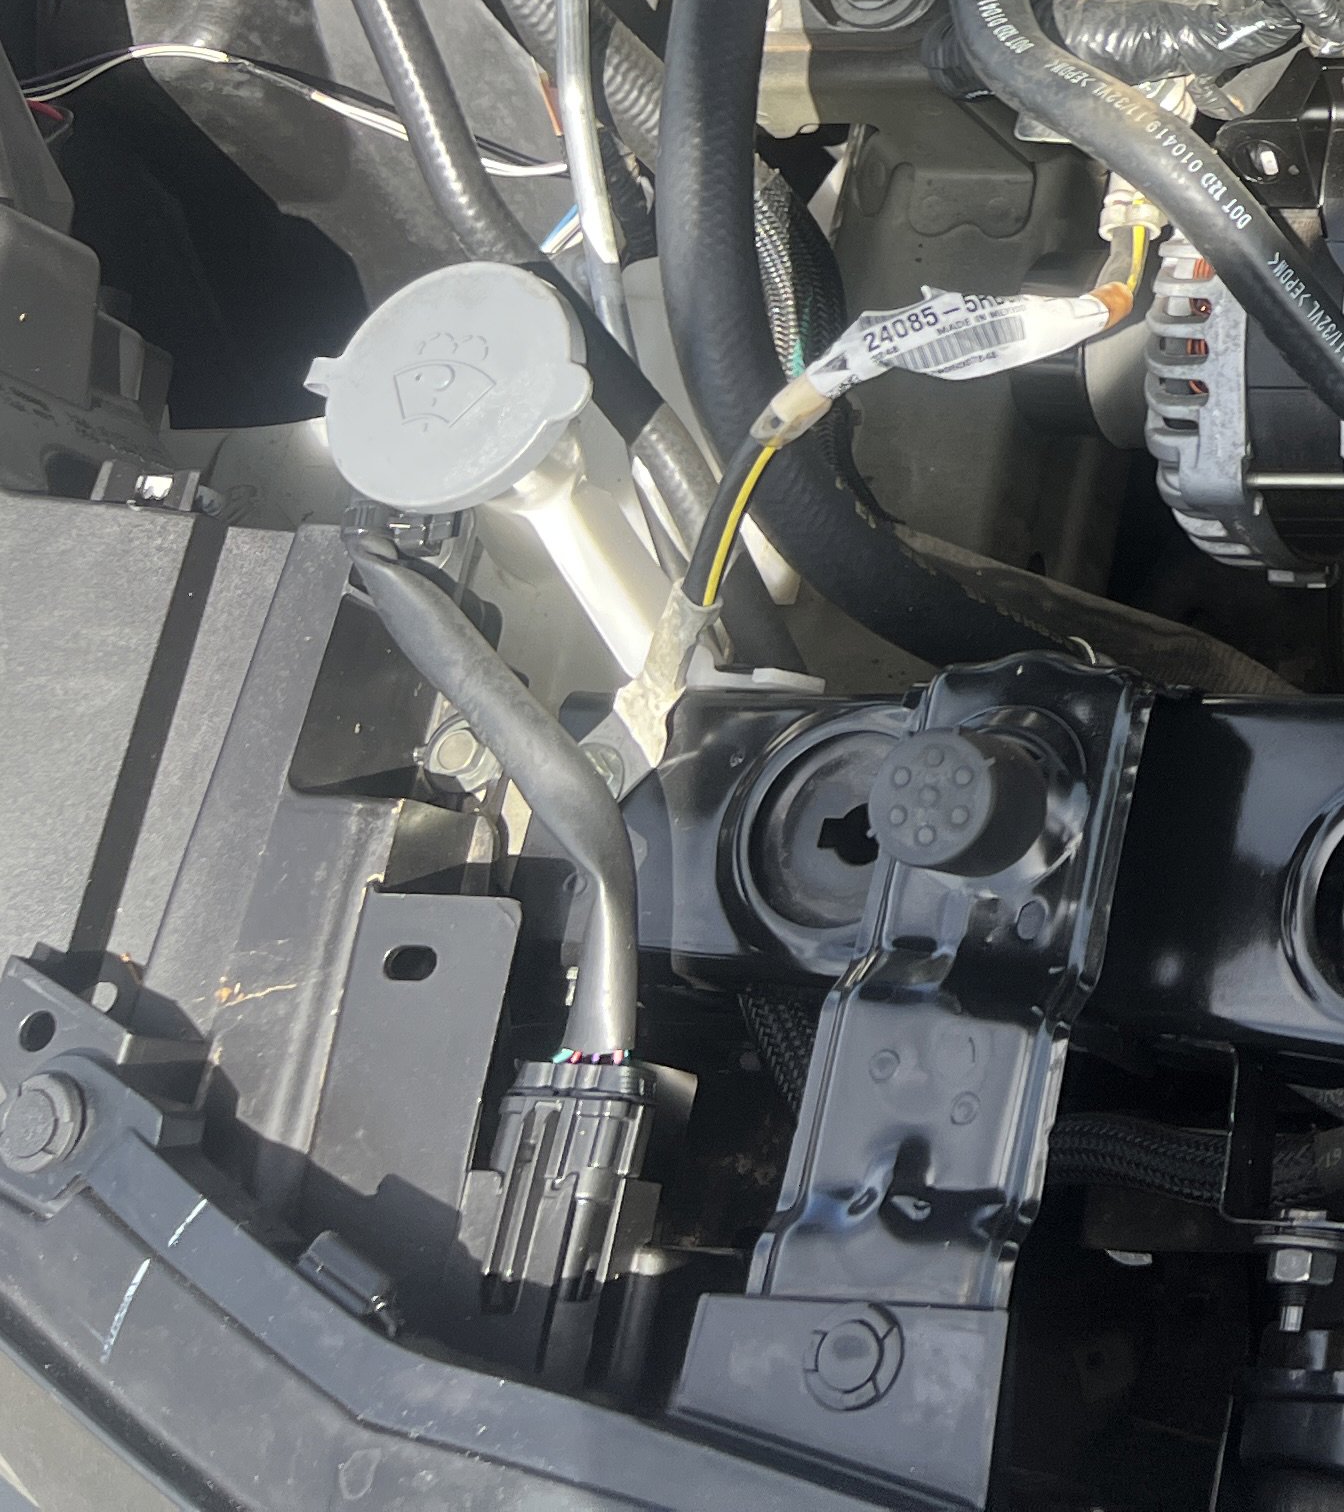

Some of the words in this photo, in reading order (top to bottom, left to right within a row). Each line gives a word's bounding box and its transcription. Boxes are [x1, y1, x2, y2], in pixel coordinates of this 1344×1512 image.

[1222, 198, 1253, 230] DOT
[936, 317, 974, 337] MADE
[974, 312, 989, 324] IN
